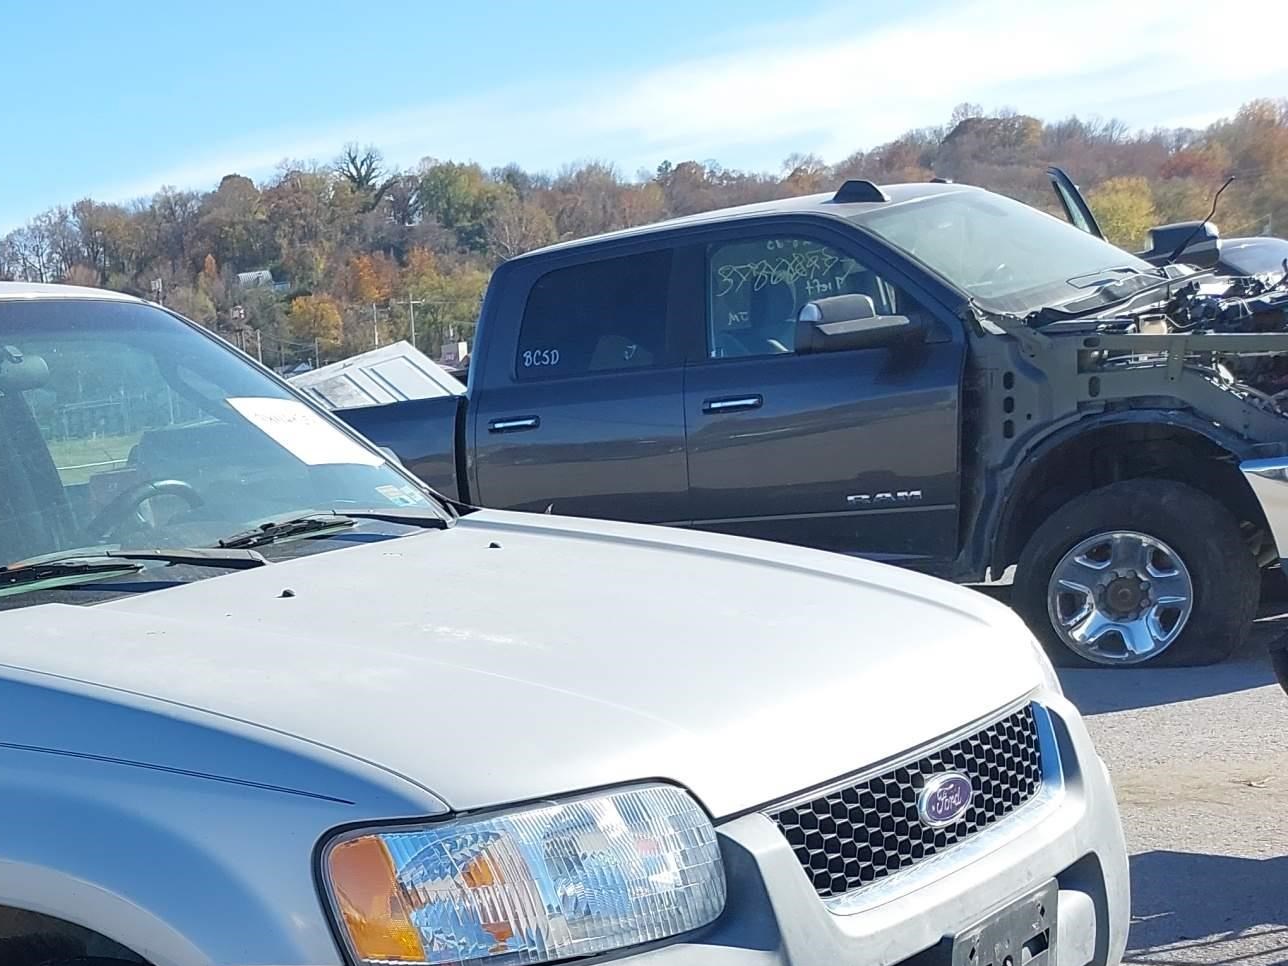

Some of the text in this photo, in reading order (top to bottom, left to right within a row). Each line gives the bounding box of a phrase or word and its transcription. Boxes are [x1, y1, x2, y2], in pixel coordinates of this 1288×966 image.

[522, 348, 560, 367] BCSD
[846, 489, 923, 505] RAM
[932, 783, 962, 815] Ford
